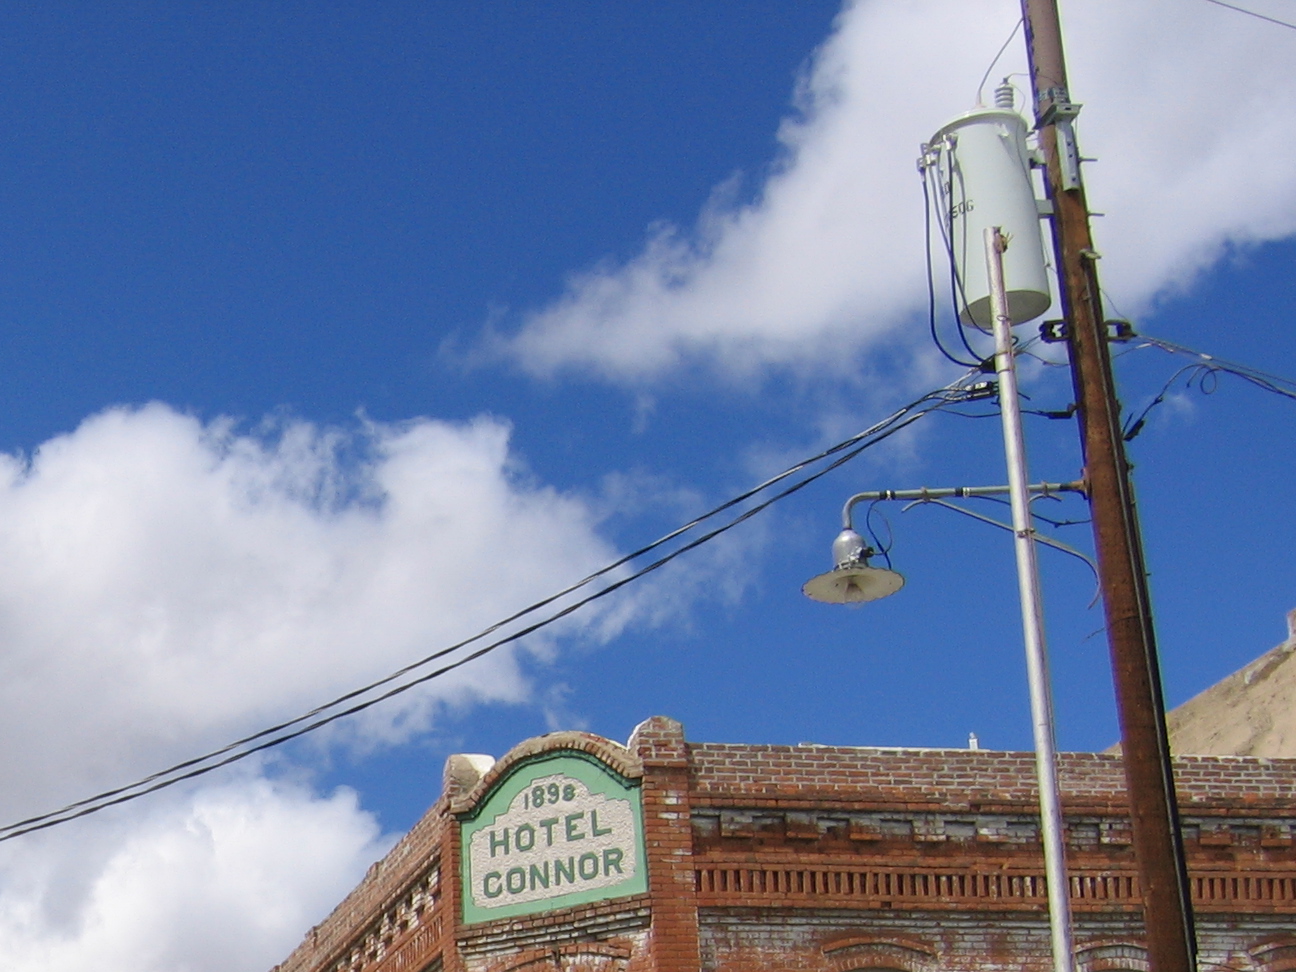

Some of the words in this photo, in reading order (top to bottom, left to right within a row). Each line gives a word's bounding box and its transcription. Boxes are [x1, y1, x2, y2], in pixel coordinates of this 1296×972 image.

[524, 783, 576, 810] 1898
[489, 809, 613, 858] HOTEL
[483, 847, 624, 898] CONNOR
